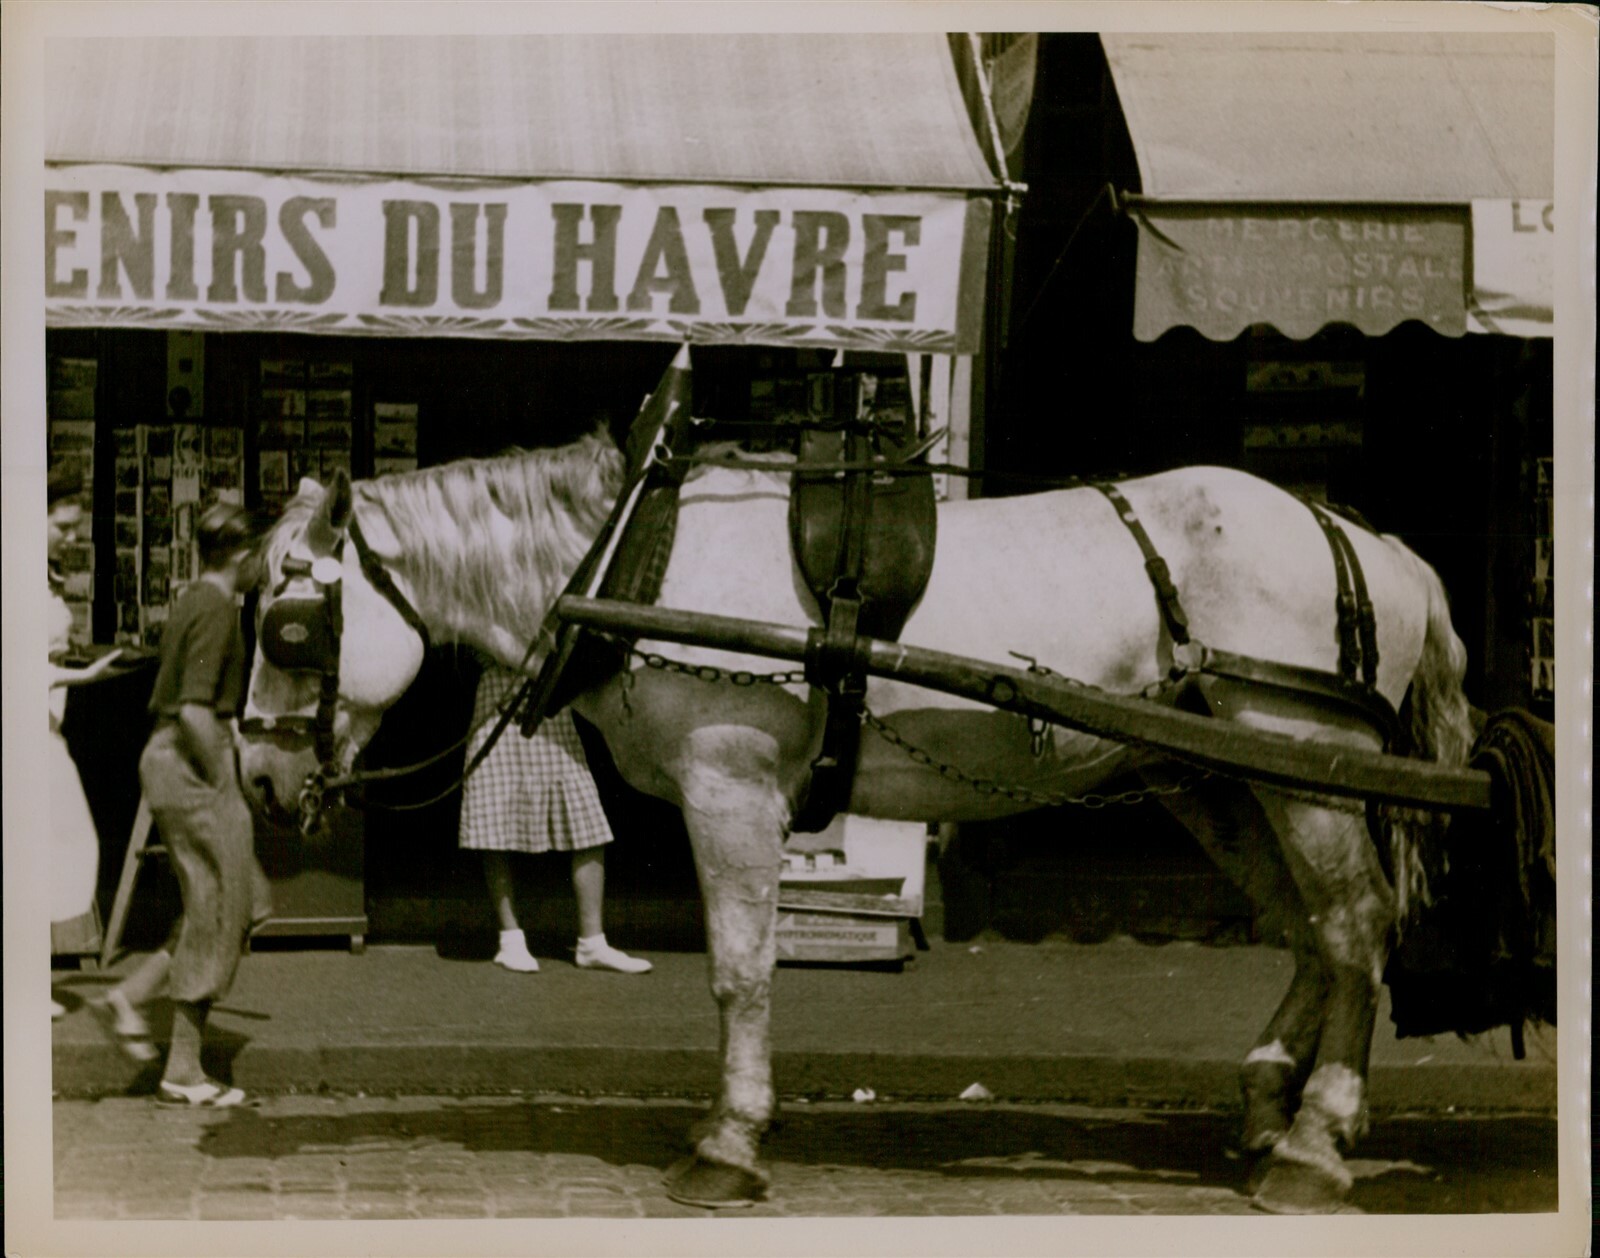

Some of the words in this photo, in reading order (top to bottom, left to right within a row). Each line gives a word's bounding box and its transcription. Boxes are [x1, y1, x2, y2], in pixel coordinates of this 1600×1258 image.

[1207, 218, 1425, 243] MERCERIE
[45, 190, 337, 306] ENIRS
[379, 199, 508, 310] DU
[547, 202, 922, 323] HAVRE
[1187, 285, 1426, 312] SOUVENIRS
